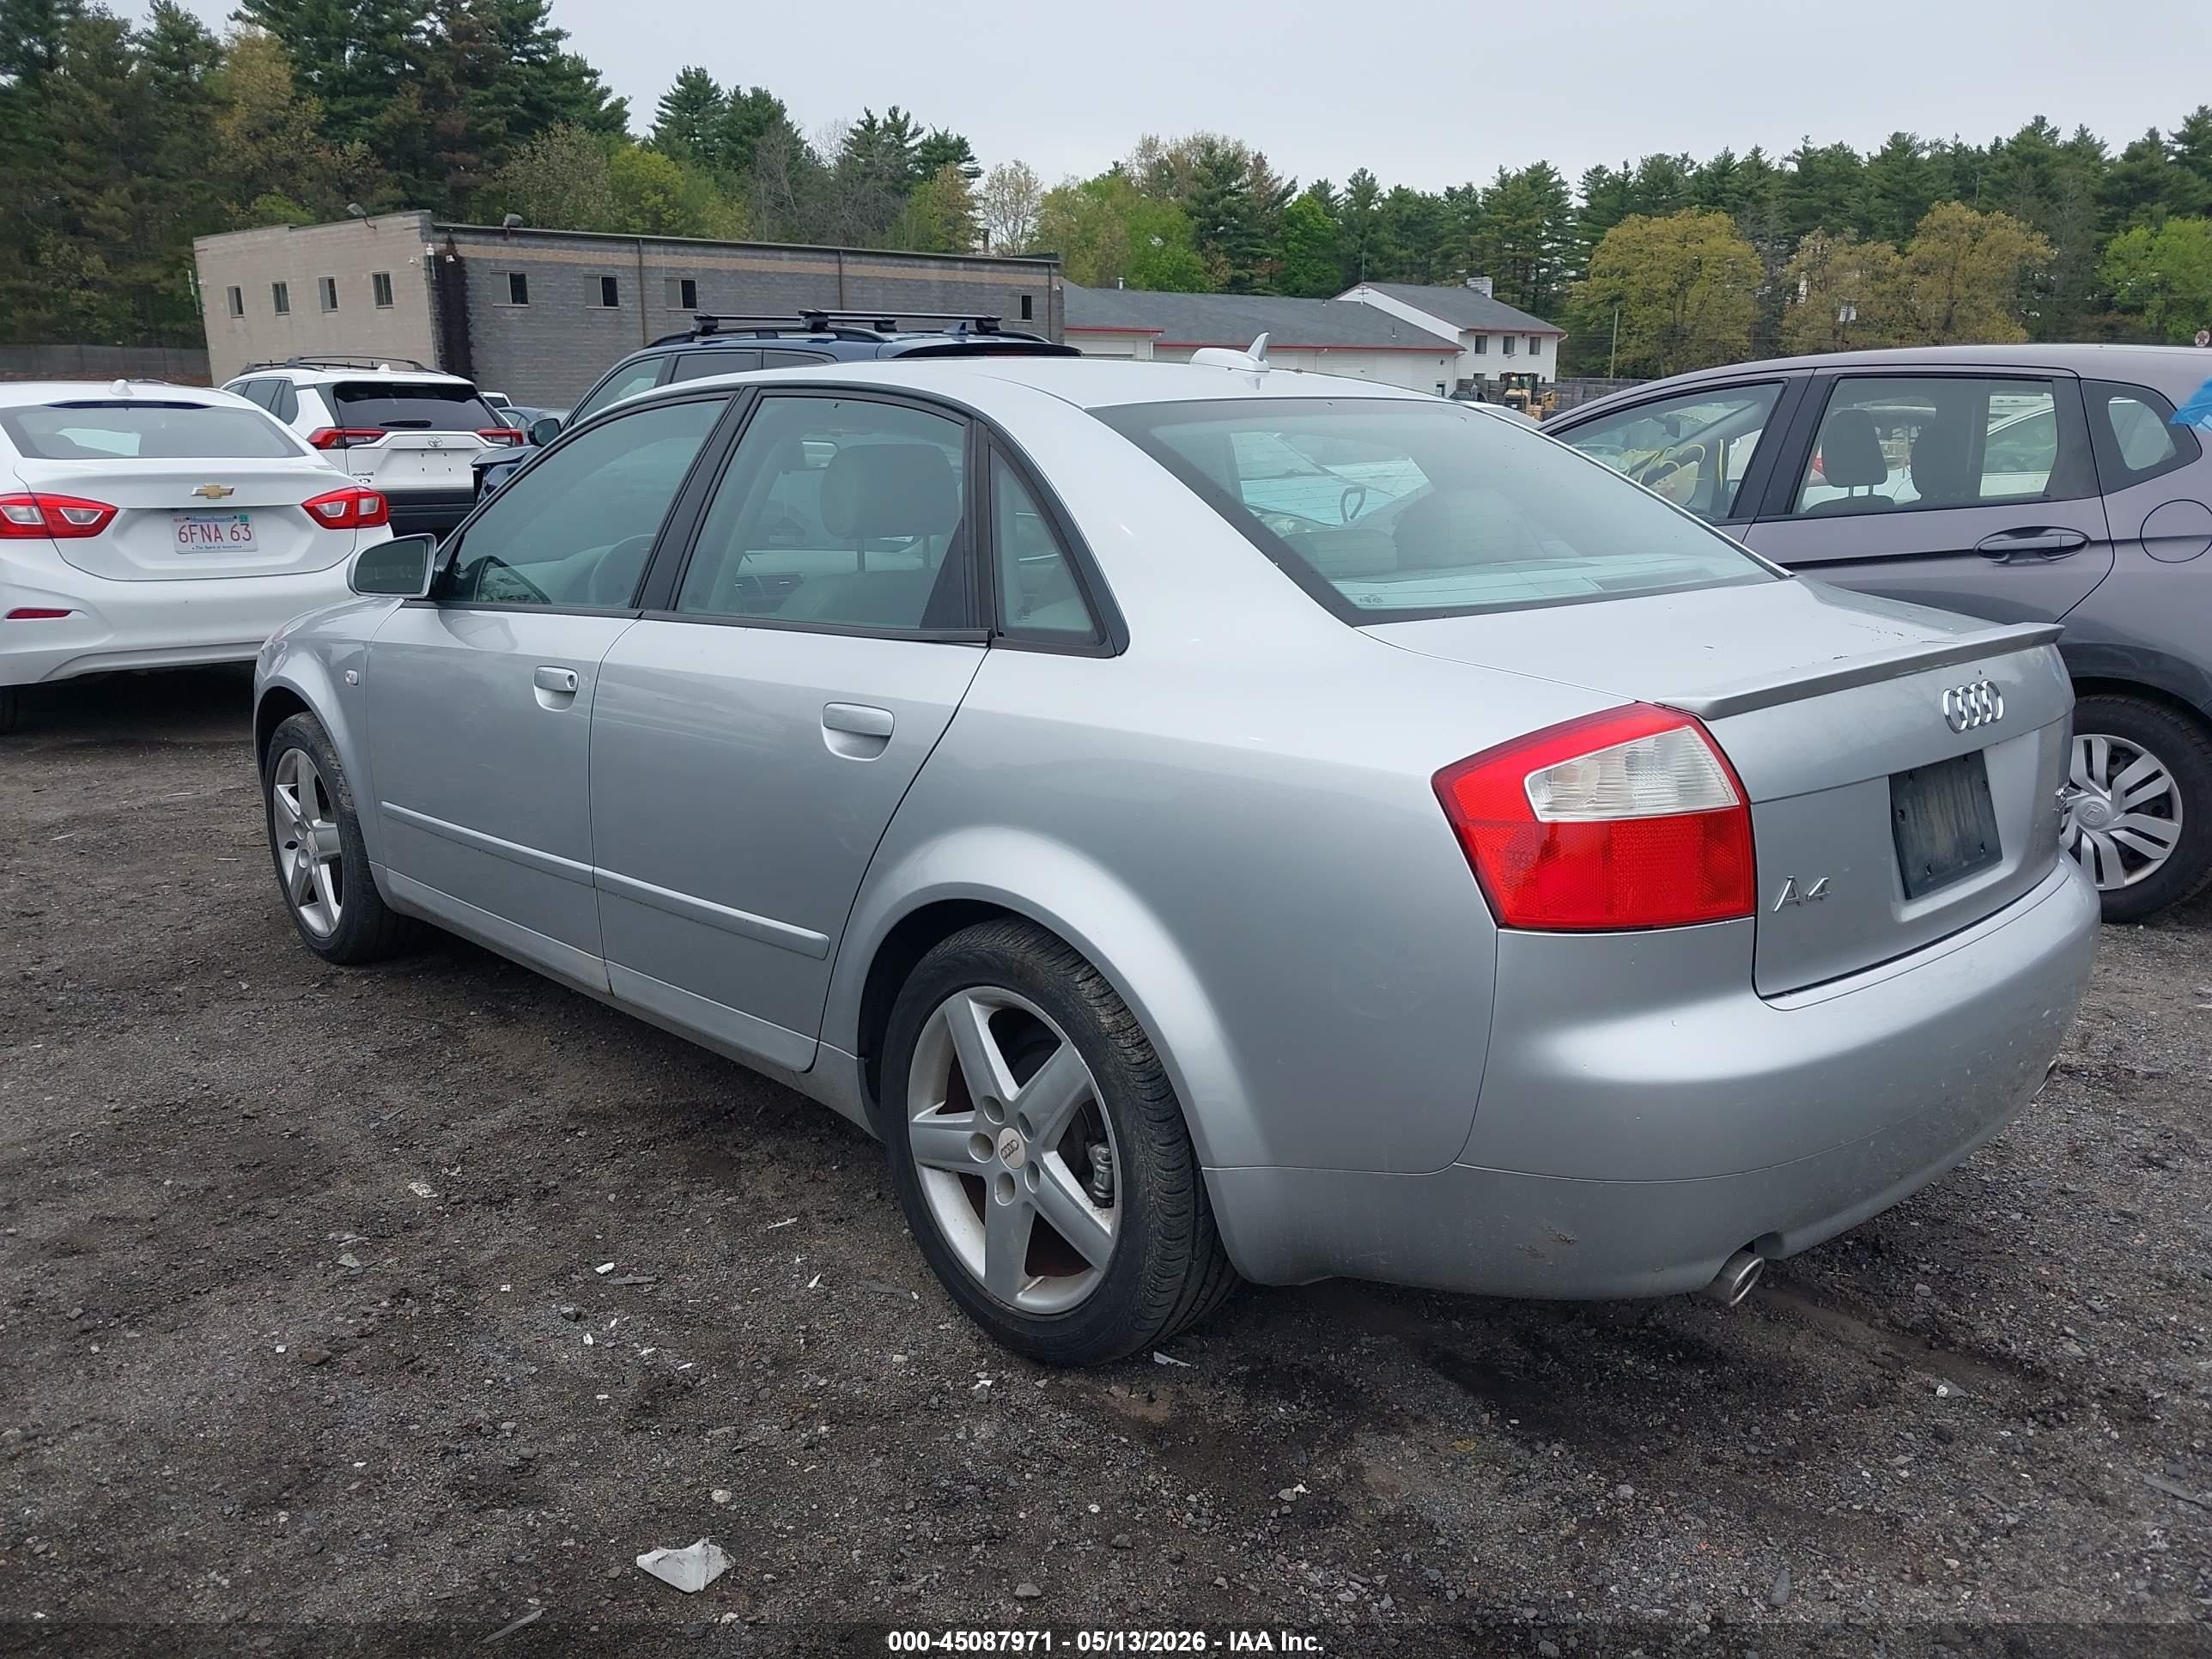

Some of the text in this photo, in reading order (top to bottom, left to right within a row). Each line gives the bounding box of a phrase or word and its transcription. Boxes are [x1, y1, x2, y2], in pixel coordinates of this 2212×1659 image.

[178, 523, 252, 544] 6FNA 63
[1772, 875, 1831, 913] A4
